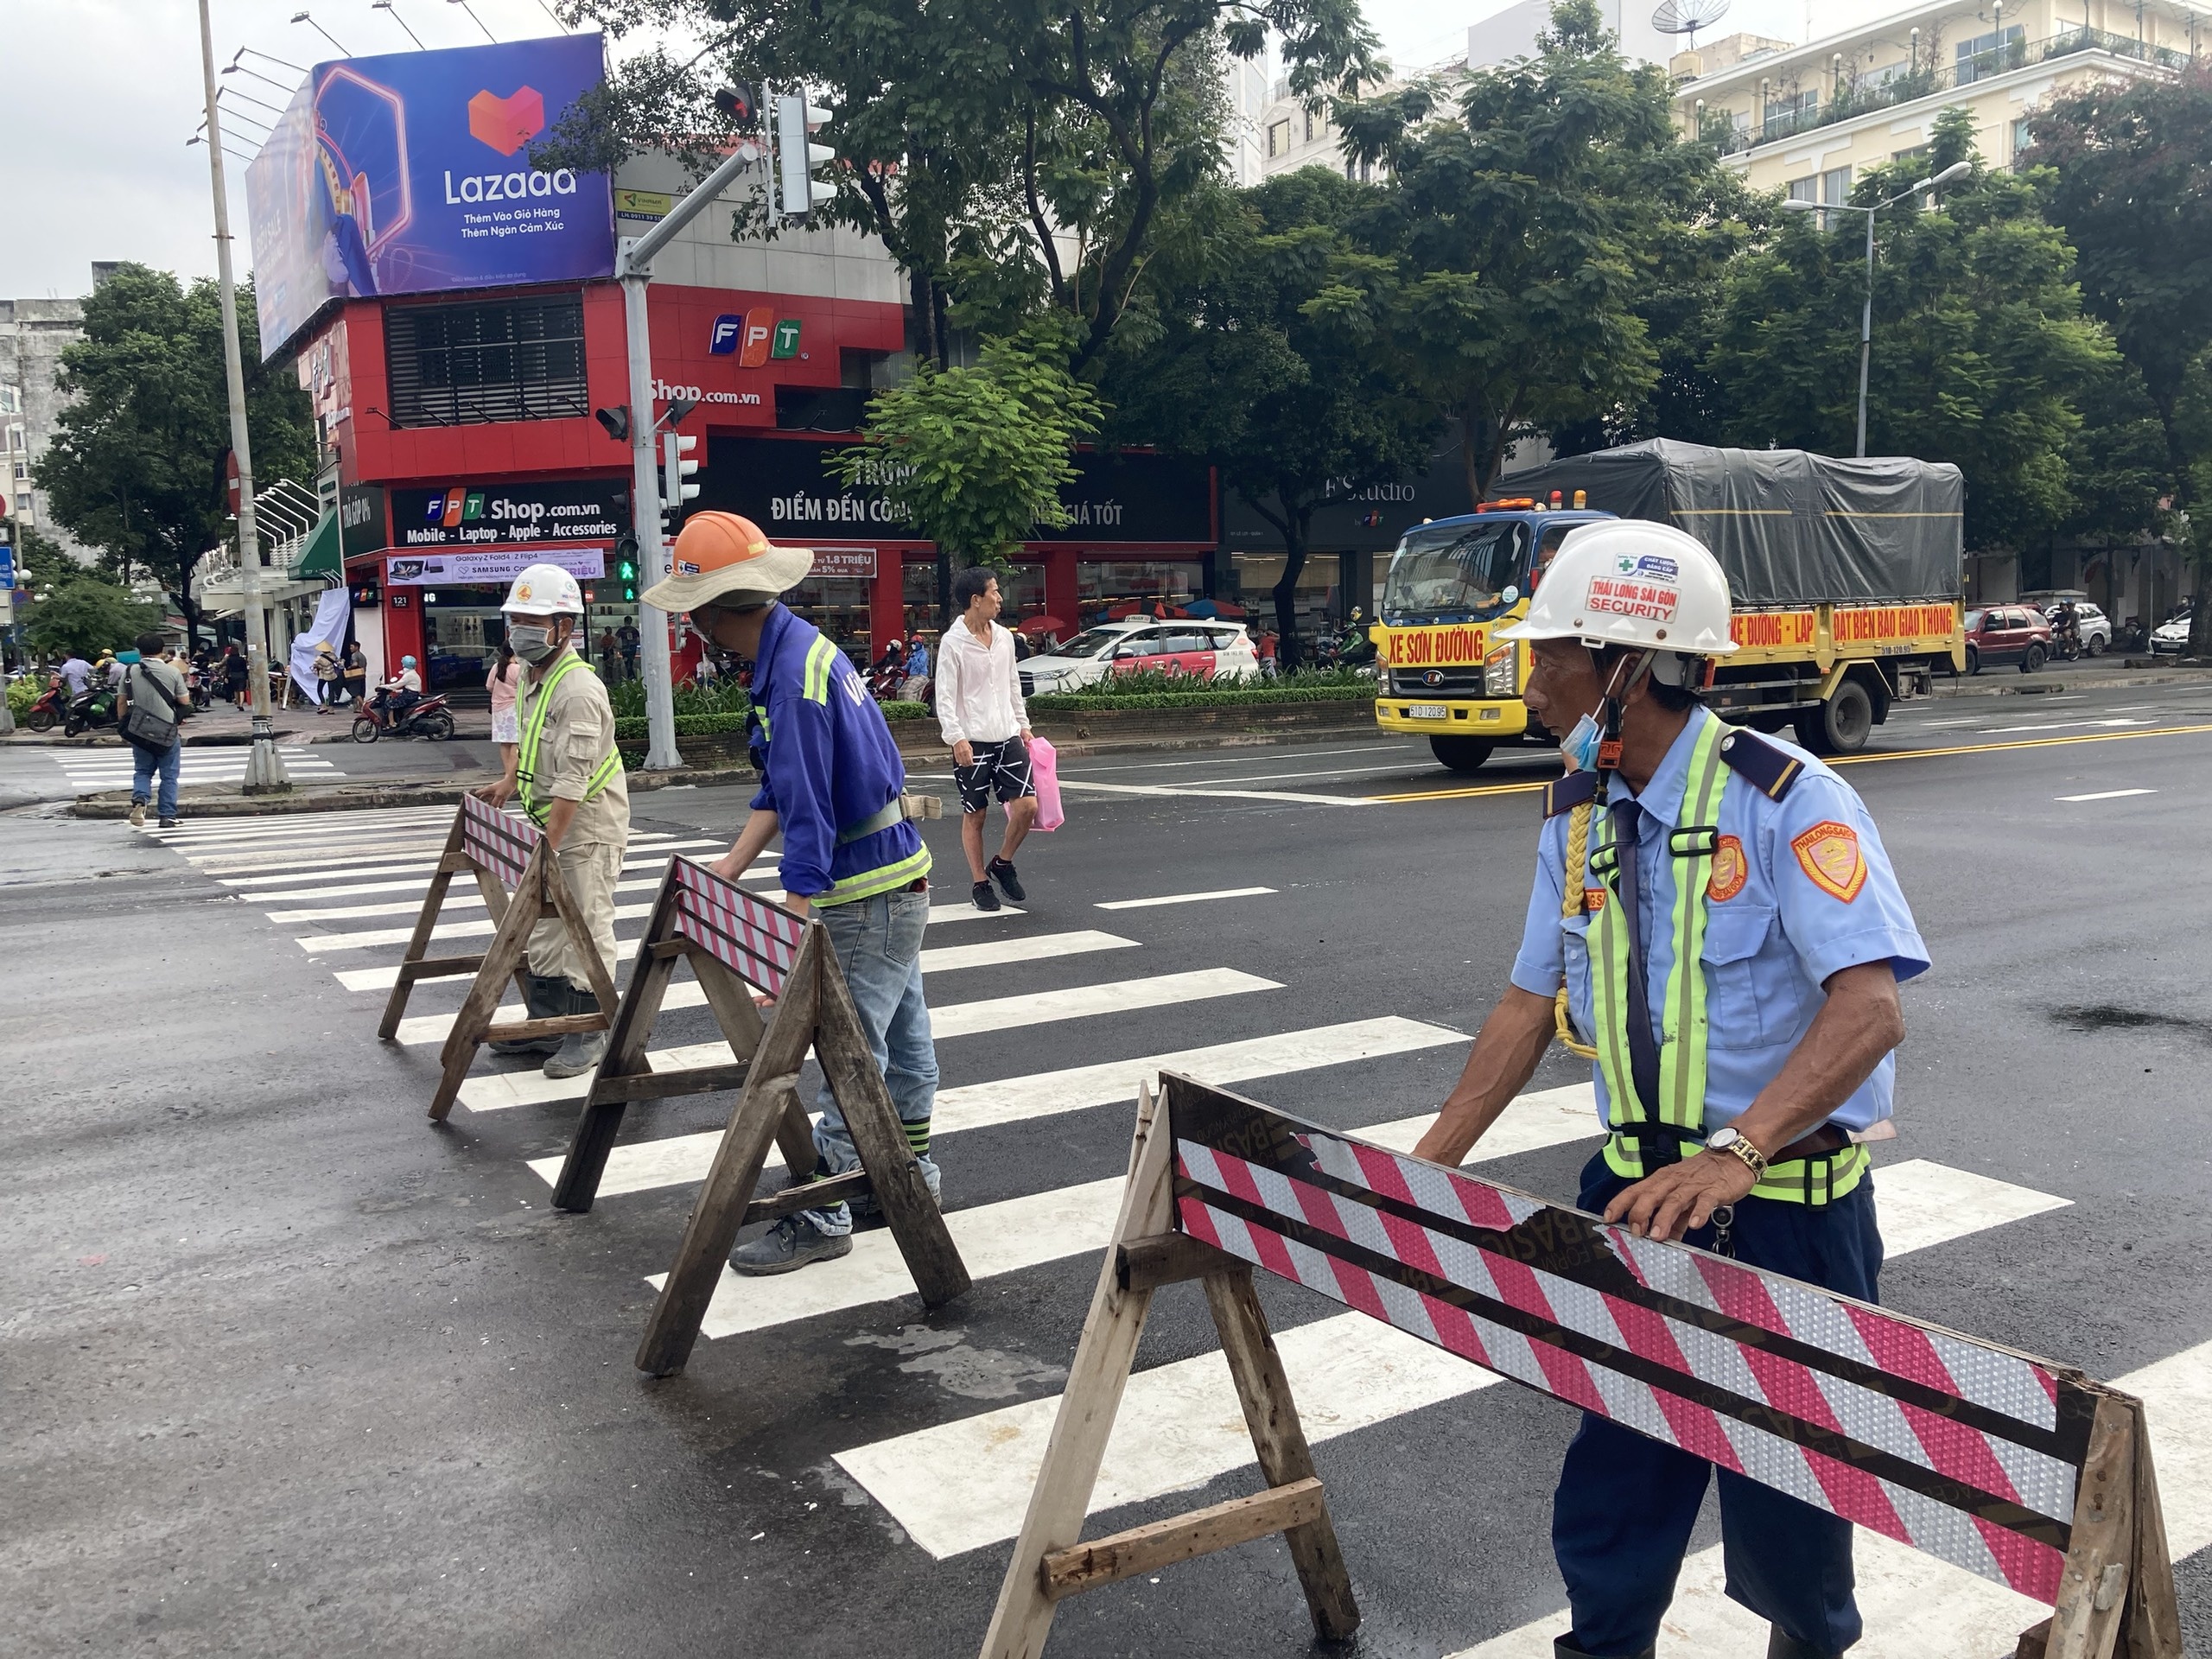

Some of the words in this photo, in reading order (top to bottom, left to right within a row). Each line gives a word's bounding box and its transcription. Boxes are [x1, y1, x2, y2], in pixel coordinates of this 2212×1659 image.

[493, 211, 512, 222] Vào
[514, 208, 531, 220] Giỏ
[533, 207, 561, 219] Hàng
[491, 226, 518, 238] Ngàn
[519, 222, 543, 233] Cảm
[544, 221, 564, 232] Xúc
[771, 491, 821, 520] ĐIỂM
[826, 493, 865, 522] ĐẾN
[1094, 499, 1123, 525] TỐT
[408, 527, 446, 543] Mobile
[460, 527, 498, 543] Laptop
[509, 524, 541, 541] Apple
[553, 522, 617, 537] Accessories
[454, 555, 483, 563] Galaxy
[489, 553, 511, 562] Fold4
[826, 556, 840, 564] 1.8
[842, 553, 871, 566] TRIỆU
[472, 565, 512, 574] SAMSUNG
[566, 565, 596, 577] RIỆU
[1592, 580, 1612, 596] THÁI
[1614, 583, 1638, 601] LONG
[1640, 586, 1656, 603] SÀI
[1657, 588, 1677, 607] GÒN
[1590, 597, 1673, 620] SECURITY
[1899, 608, 1920, 637] GIAO
[1389, 634, 1403, 664] XE
[1407, 631, 1431, 664] SƠN
[1435, 626, 1484, 664] ĐƯỜNG
